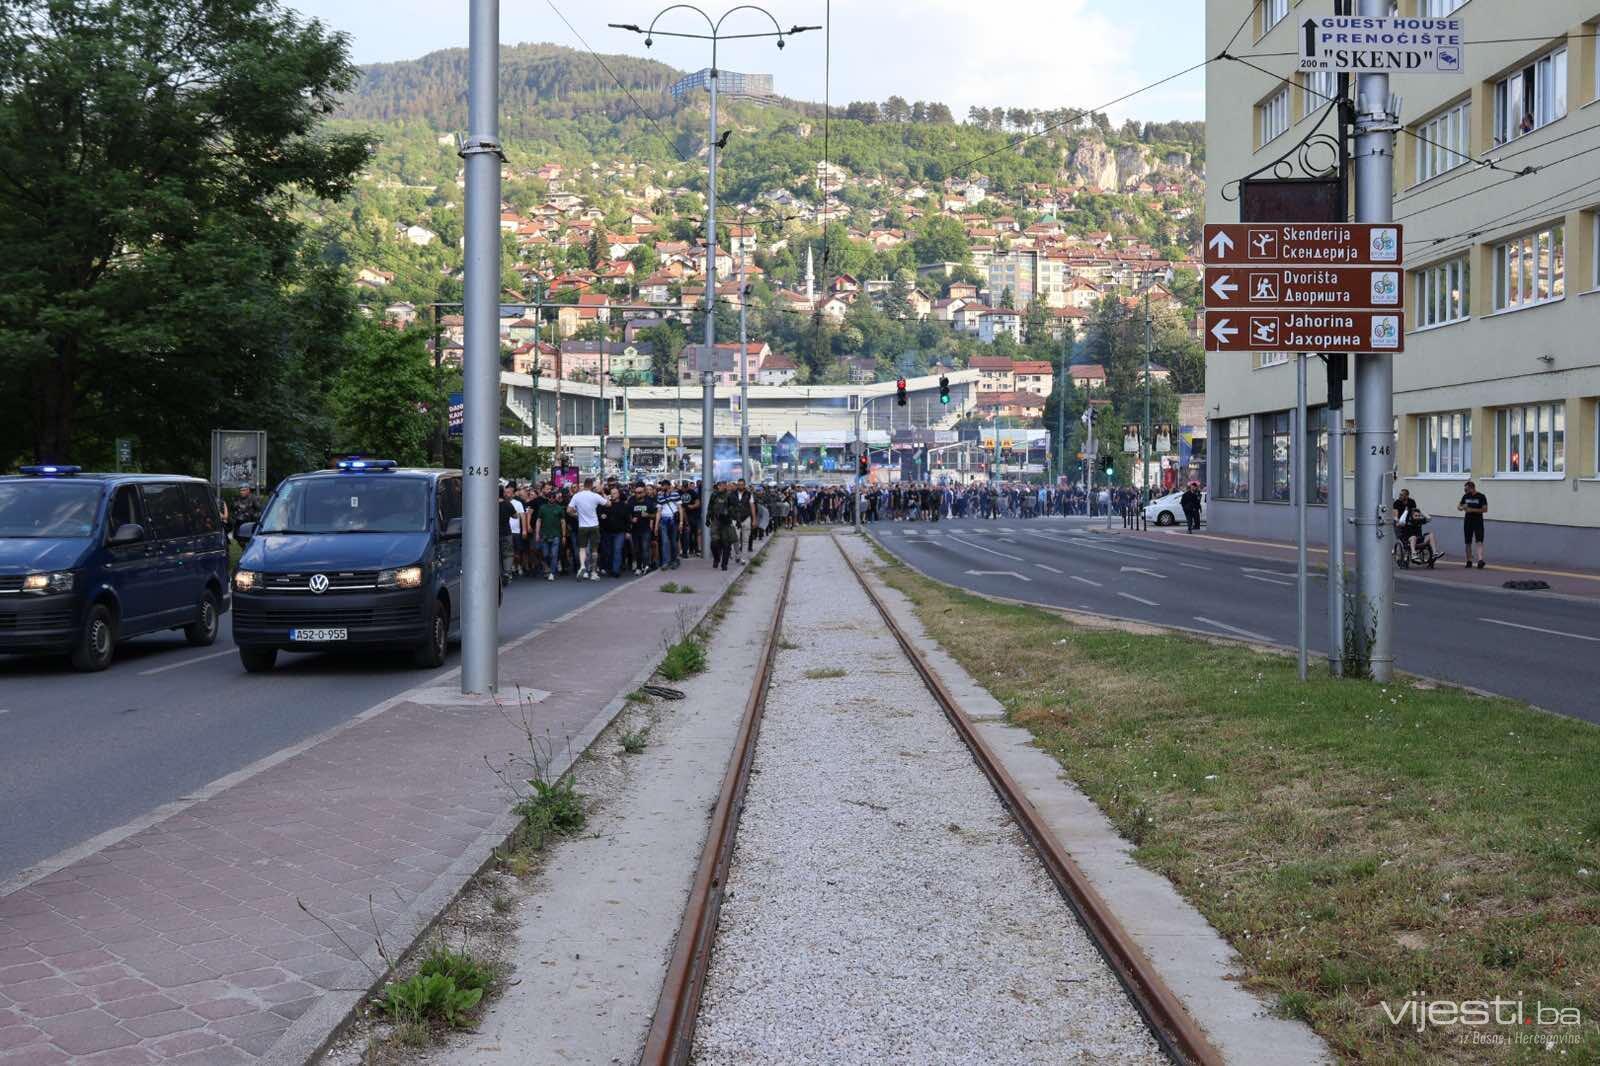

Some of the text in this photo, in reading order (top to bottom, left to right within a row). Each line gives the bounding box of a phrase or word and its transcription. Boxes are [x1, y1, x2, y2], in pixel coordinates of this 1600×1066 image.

[1322, 18, 1460, 30] GUEST HOUSE
[1322, 31, 1460, 45] PRENOĆIŠTE
[1301, 59, 1328, 68] 200 m
[1324, 49, 1433, 68] "SKEND"
[1283, 226, 1351, 244] Skenderija
[1283, 245, 1358, 262] Скендерија
[1284, 270, 1338, 284] Dvorišta
[1284, 288, 1350, 305] Дворишта
[1284, 314, 1353, 328] Jahorina
[1284, 332, 1361, 349] Јахорина
[1370, 445, 1391, 456] 246
[469, 465, 489, 477] 245
